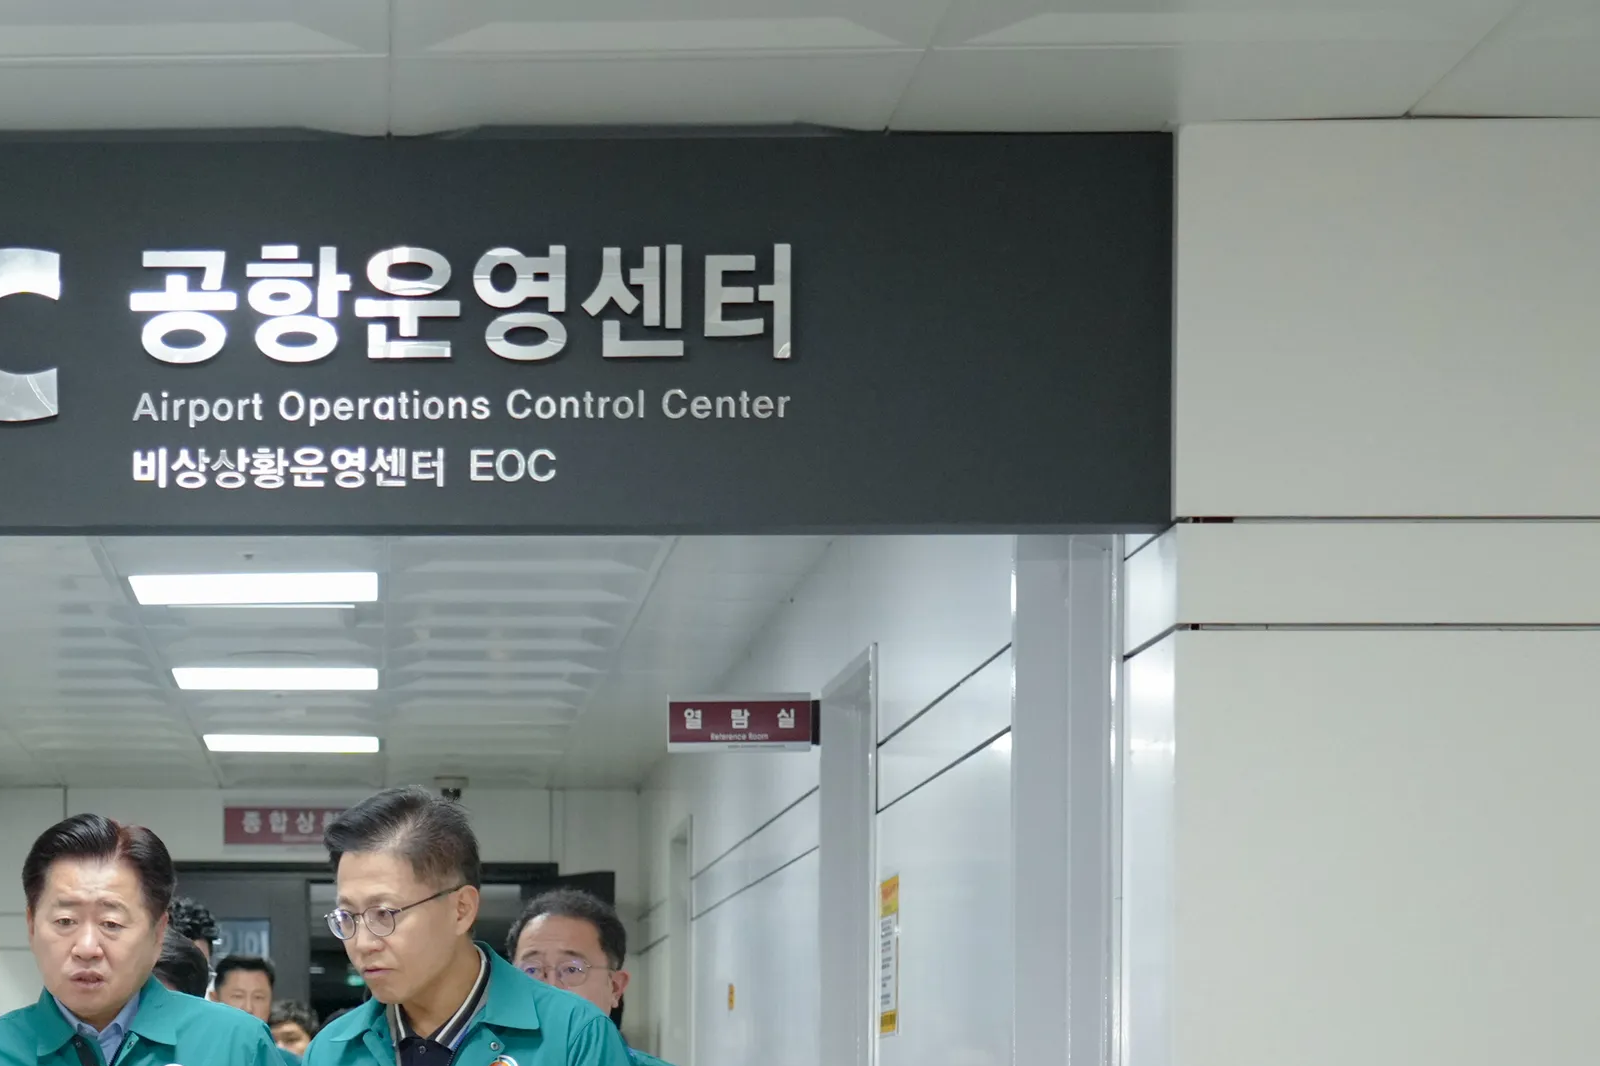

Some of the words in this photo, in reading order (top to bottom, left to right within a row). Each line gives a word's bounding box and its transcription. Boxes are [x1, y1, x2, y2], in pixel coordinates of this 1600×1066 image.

[129, 243, 791, 364] 공항운영센터
[132, 391, 264, 428] Airport
[278, 390, 491, 427] Operations
[506, 389, 645, 420] Control
[662, 389, 791, 419] Center
[132, 447, 445, 489] 비상상황운영센터
[469, 449, 557, 483] EOC
[710, 732, 747, 741] Reference
[748, 732, 769, 741] Room
